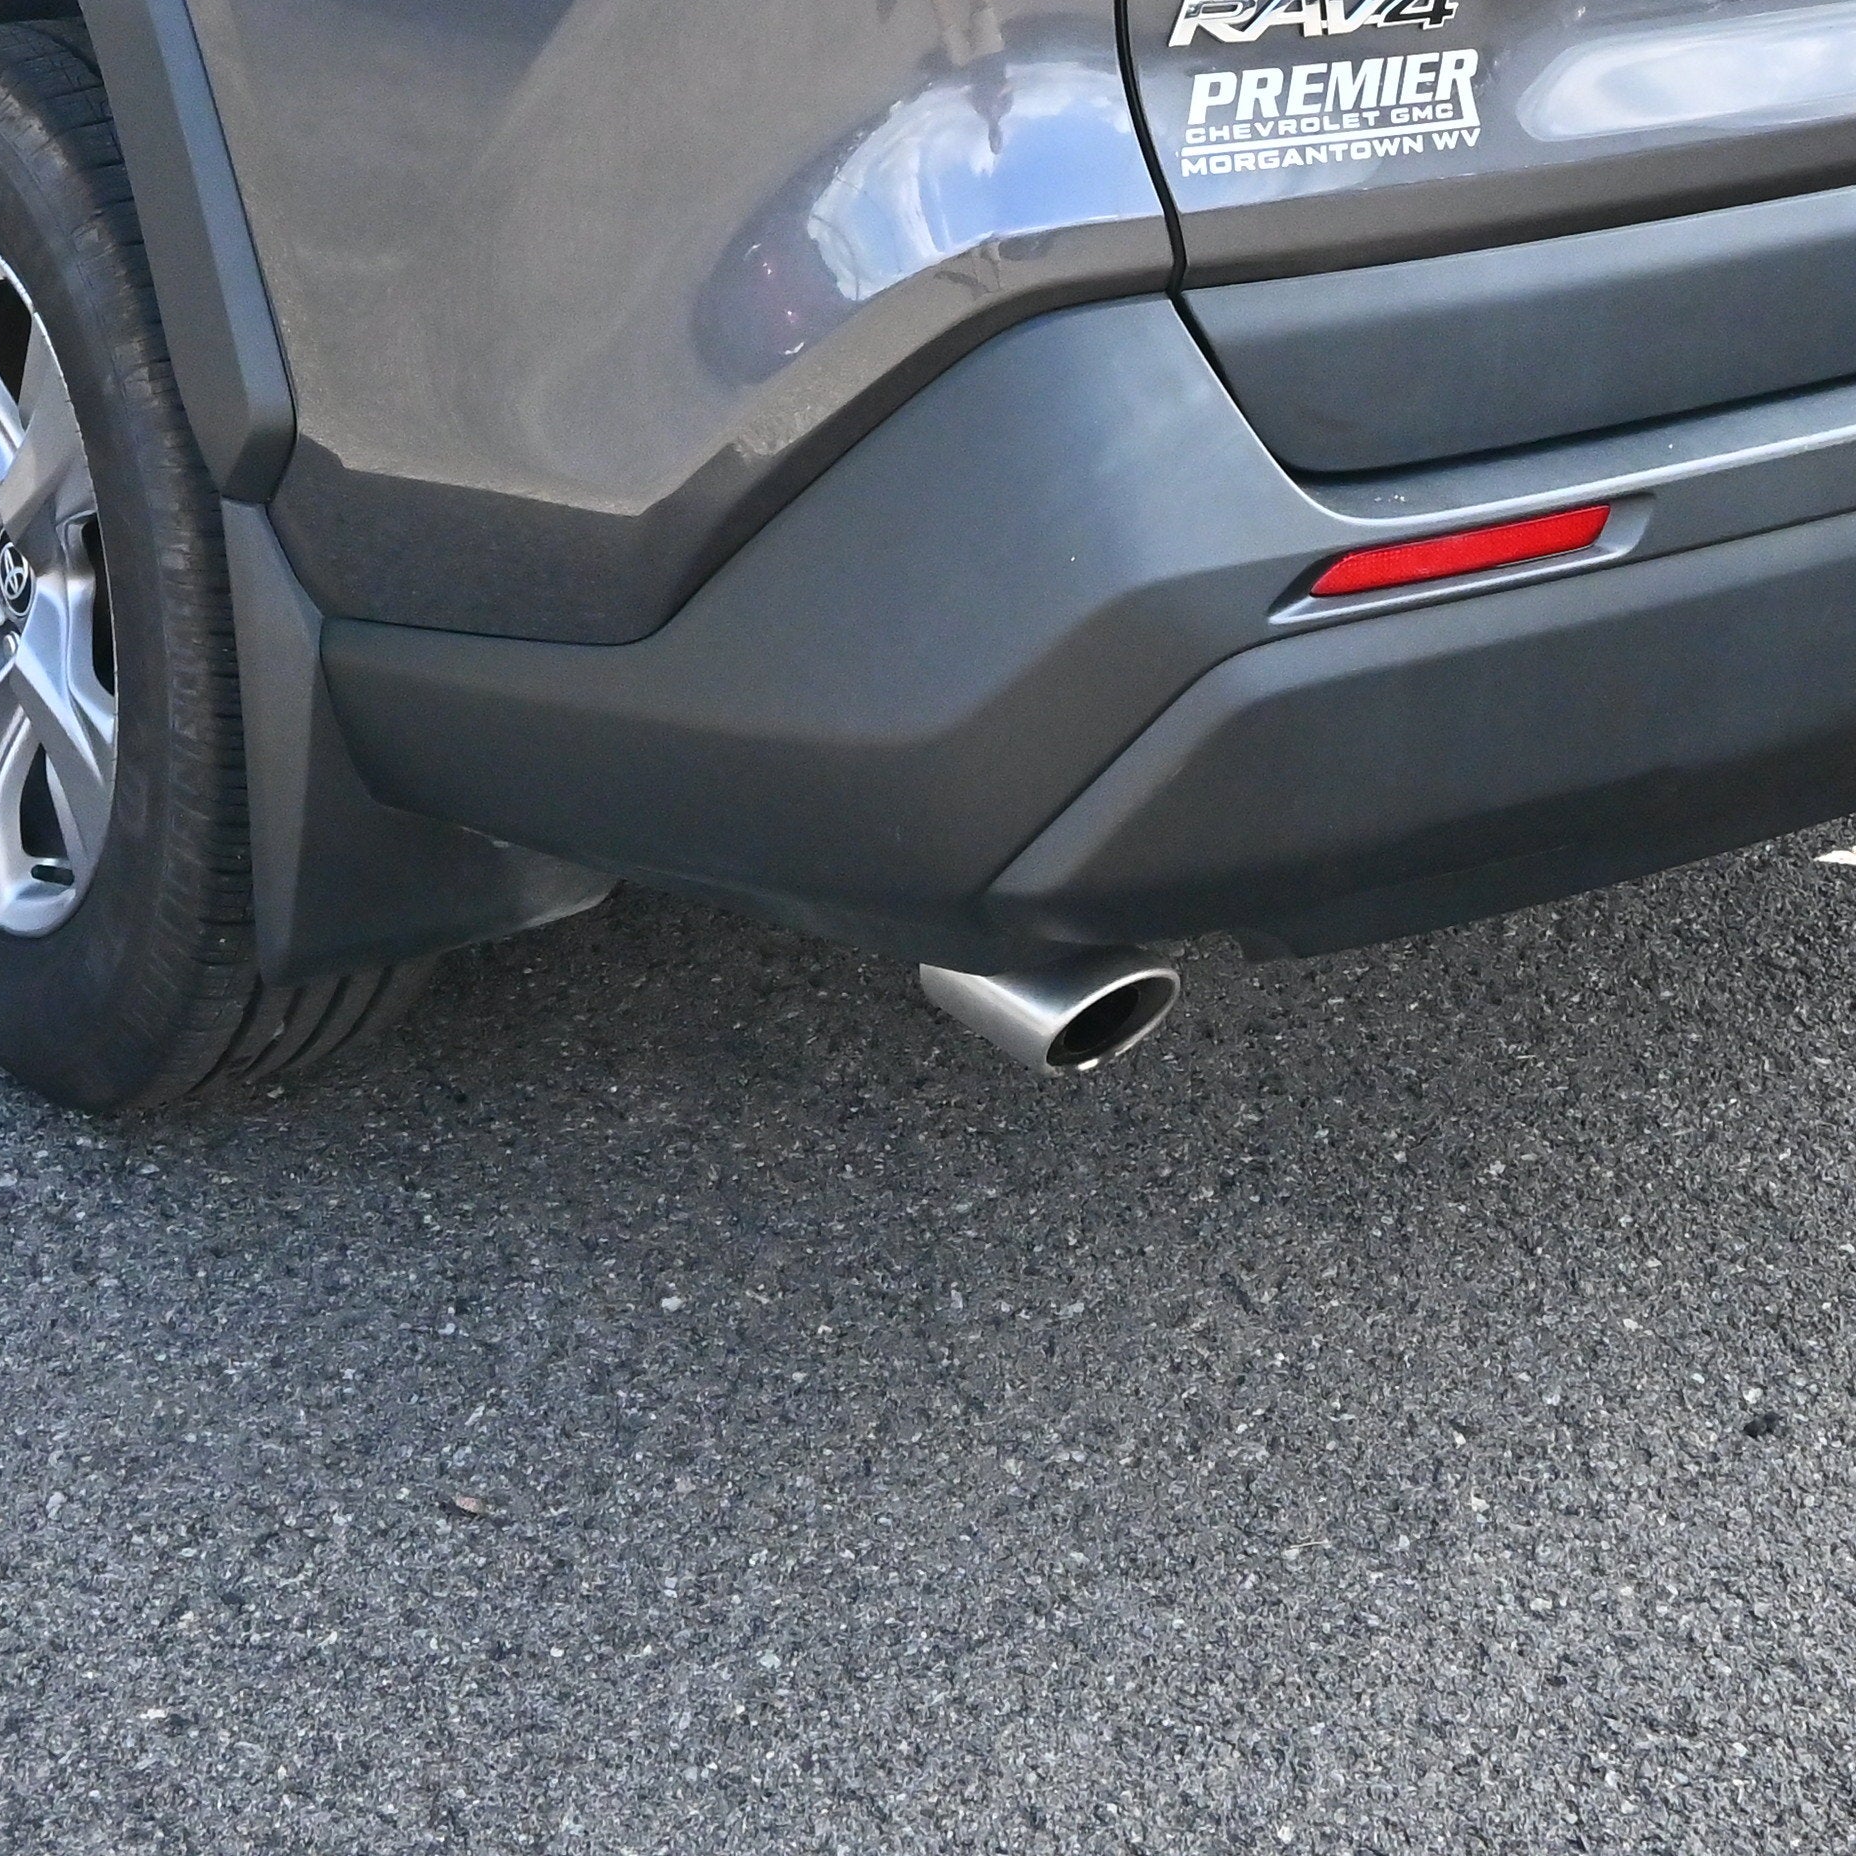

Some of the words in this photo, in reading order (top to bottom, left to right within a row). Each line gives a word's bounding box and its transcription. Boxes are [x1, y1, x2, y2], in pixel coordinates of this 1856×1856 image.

[1187, 48, 1480, 126] PREMIER
[1185, 110, 1380, 144] CHEVROLET
[1390, 102, 1455, 124] GMC
[1181, 135, 1424, 177] MORGANTOWN
[1431, 127, 1481, 151] WV
